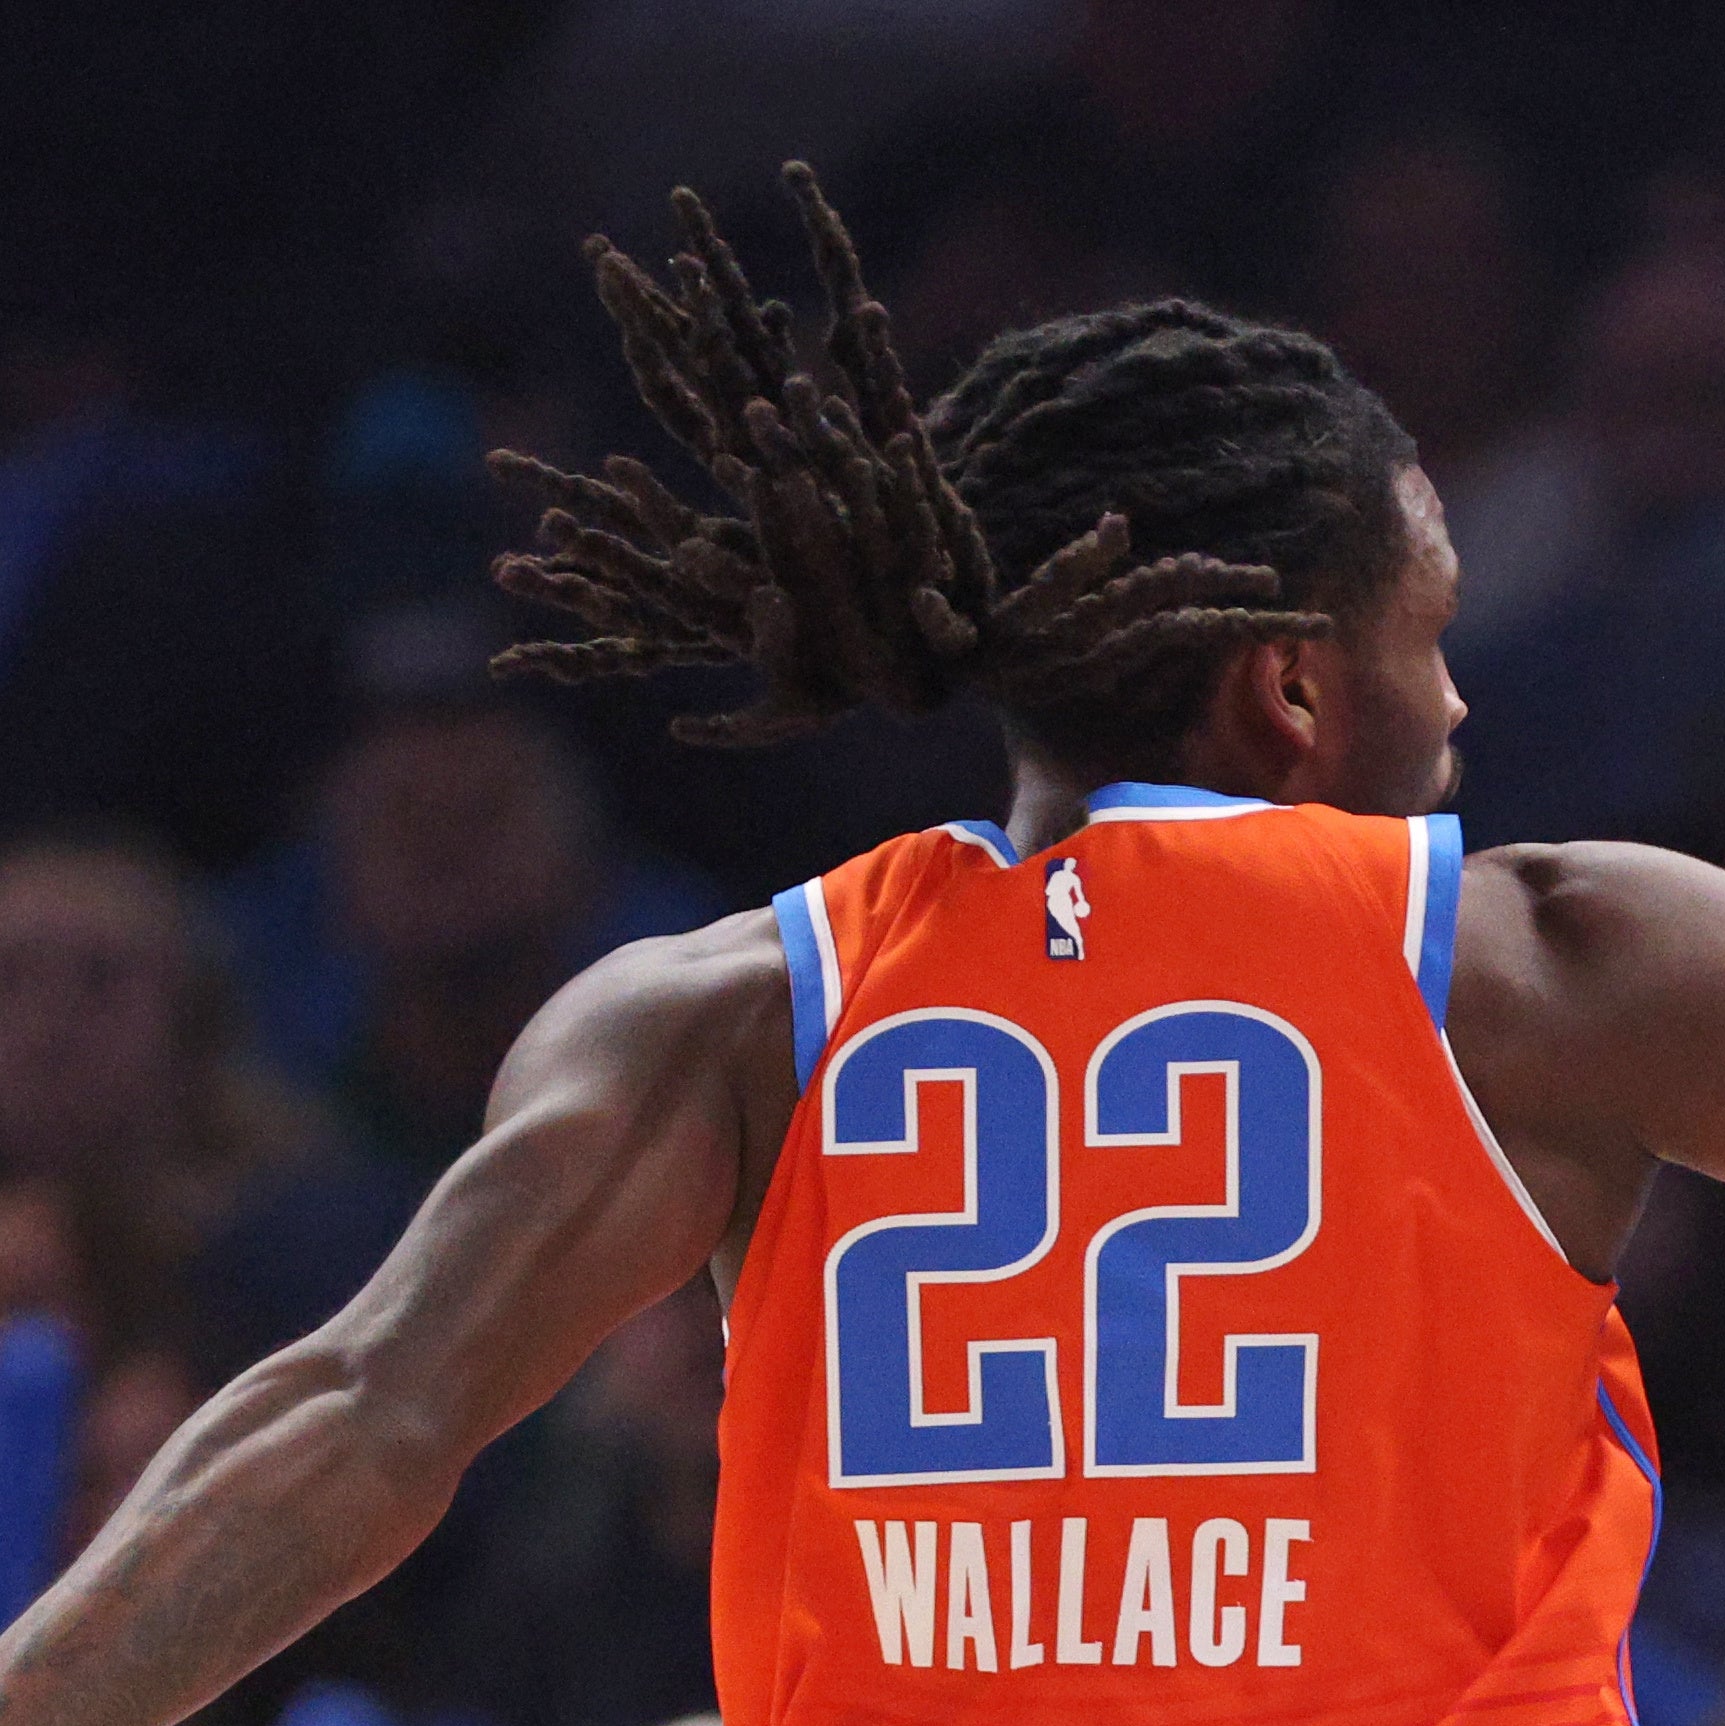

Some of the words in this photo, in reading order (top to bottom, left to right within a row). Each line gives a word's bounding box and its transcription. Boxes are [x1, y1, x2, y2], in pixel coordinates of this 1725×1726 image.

[1049, 937, 1075, 956] NBA
[822, 1000, 1322, 1489] 22
[854, 1517, 1313, 1673] WALLACE
